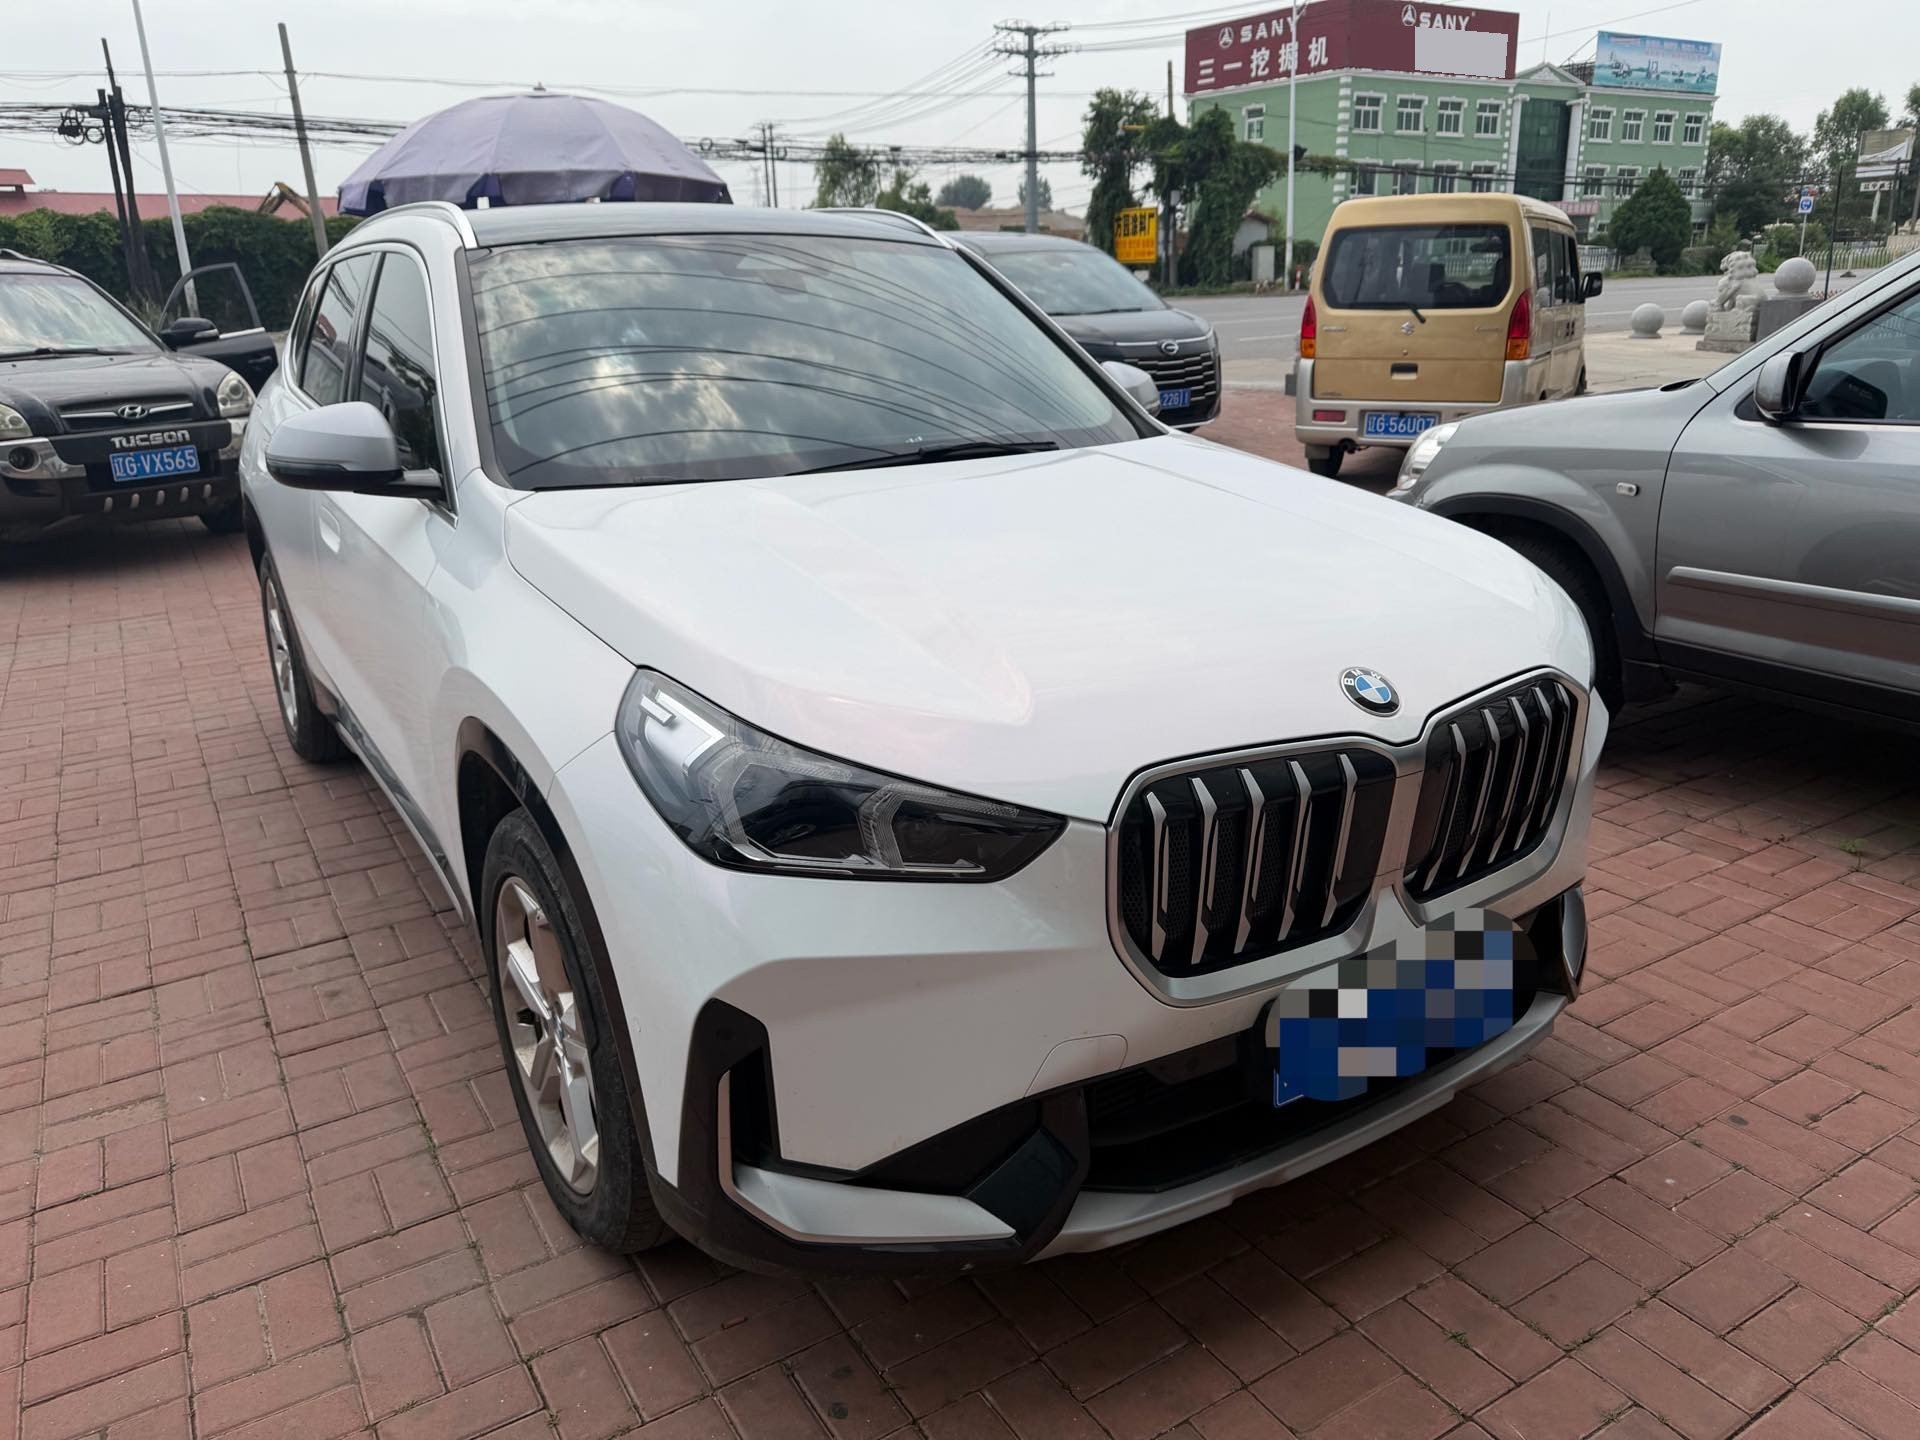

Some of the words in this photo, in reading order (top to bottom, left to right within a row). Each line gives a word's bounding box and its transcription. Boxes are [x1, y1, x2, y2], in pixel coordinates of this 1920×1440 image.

[1420, 11, 1469, 31] SANY
[1197, 36, 1328, 85] 三一挖掘机
[111, 430, 190, 449] TUCSON
[1344, 669, 1382, 686] BMW
